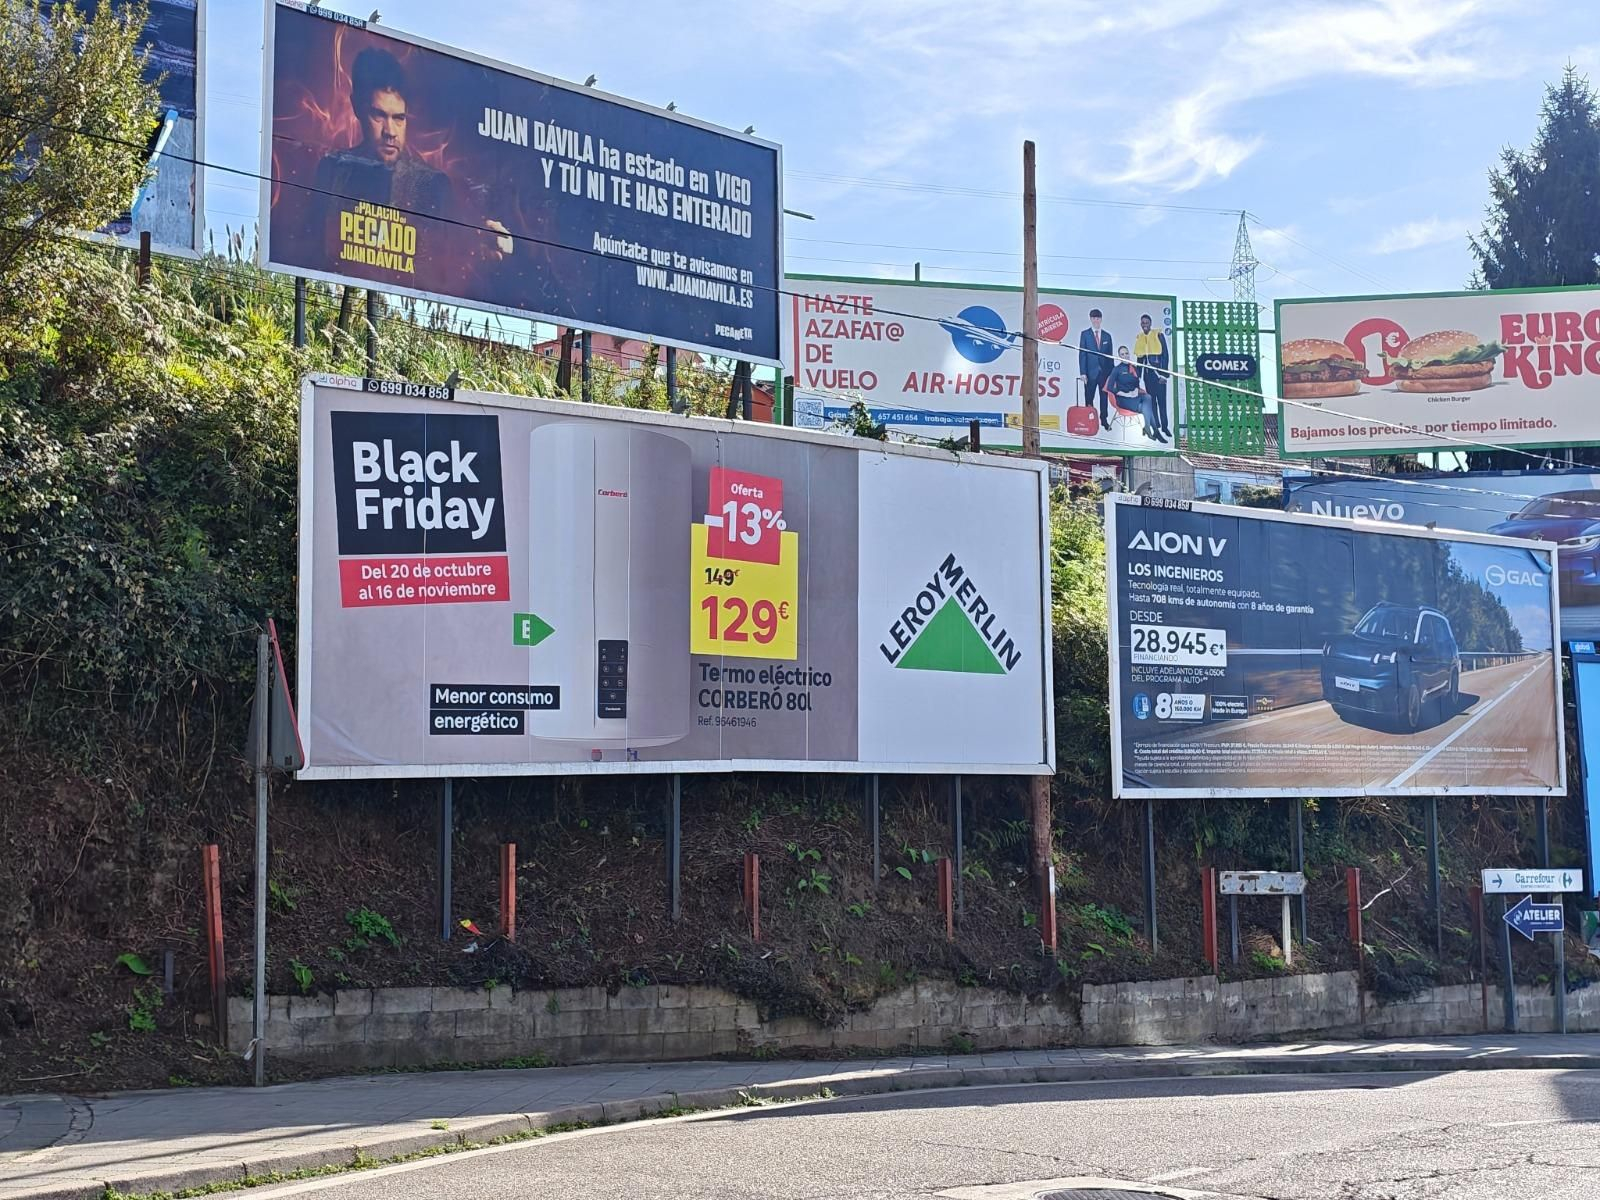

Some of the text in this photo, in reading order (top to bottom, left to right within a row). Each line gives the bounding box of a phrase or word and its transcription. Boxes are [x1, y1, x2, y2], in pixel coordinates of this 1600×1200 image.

[318, 8, 333, 19] 699
[334, 12, 348, 23] 034
[479, 108, 751, 206] JUAN DÁVILA ha estado en VIGO
[541, 158, 751, 239] Y TÚ NI TE HAS ENTERADO
[341, 211, 416, 255] PECADO
[593, 232, 753, 285] Apúntate que te avisamos en
[637, 265, 753, 309] WWW.JUANDAVILA.ES
[804, 293, 873, 316] HAZTE
[804, 319, 905, 342] AZAFAT@
[1038, 312, 1064, 329] ATRÍCULA
[805, 343, 833, 364] DE
[1203, 359, 1249, 371] COMEX
[329, 376, 357, 388] alpha
[380, 381, 449, 400] 699 034 858
[805, 369, 878, 391] VUELO
[1428, 396, 1451, 404] Chicken
[878, 413, 890, 421] 657
[892, 413, 904, 422] 451
[904, 413, 918, 422] 654
[1290, 426, 1345, 441] Bajamos
[1348, 424, 1367, 437] los
[1425, 422, 1448, 434] por
[1451, 419, 1498, 434] tiempo
[1499, 417, 1557, 431] limitado.
[352, 438, 480, 484] Black
[731, 483, 764, 499] Oferta
[355, 485, 495, 541] Friday
[1151, 497, 1190, 510] 699 034 858
[1311, 500, 1405, 521] Nuevo
[704, 500, 787, 545] -13%
[1127, 529, 1227, 557] AION V
[361, 561, 492, 580] Del 20 de octubre
[1128, 562, 1224, 583] LOS INGENIEROS
[1507, 570, 1544, 587] GAC
[358, 581, 496, 600] al 16 de noviembre
[1128, 580, 1169, 593] Tecnología
[1186, 585, 1226, 597] totalmente
[1227, 588, 1262, 599] equipado.
[879, 552, 1022, 672] LEROY MERLIN
[1128, 593, 1315, 615] Hasta 708 kms de autonomía con 8 años de garantía
[1129, 610, 1163, 623] DESDE
[522, 619, 531, 640] E
[1133, 653, 1179, 662] FINANCIANDO
[698, 662, 833, 687] Termo eléctrico
[1131, 666, 1159, 675] INCLUYE
[1160, 667, 1193, 676] ADELANTO
[1194, 668, 1204, 676] DE
[1131, 675, 1144, 683] DEL
[1145, 675, 1182, 684] PROGRAMA
[435, 688, 554, 706] Menor consumo
[698, 687, 783, 711] CORBERÓ
[1155, 693, 1172, 719] 8
[434, 713, 519, 734] energético
[697, 715, 758, 728] Ref. 96461946
[1515, 873, 1556, 884] Carrefour
[1523, 909, 1561, 921] ATELIER
